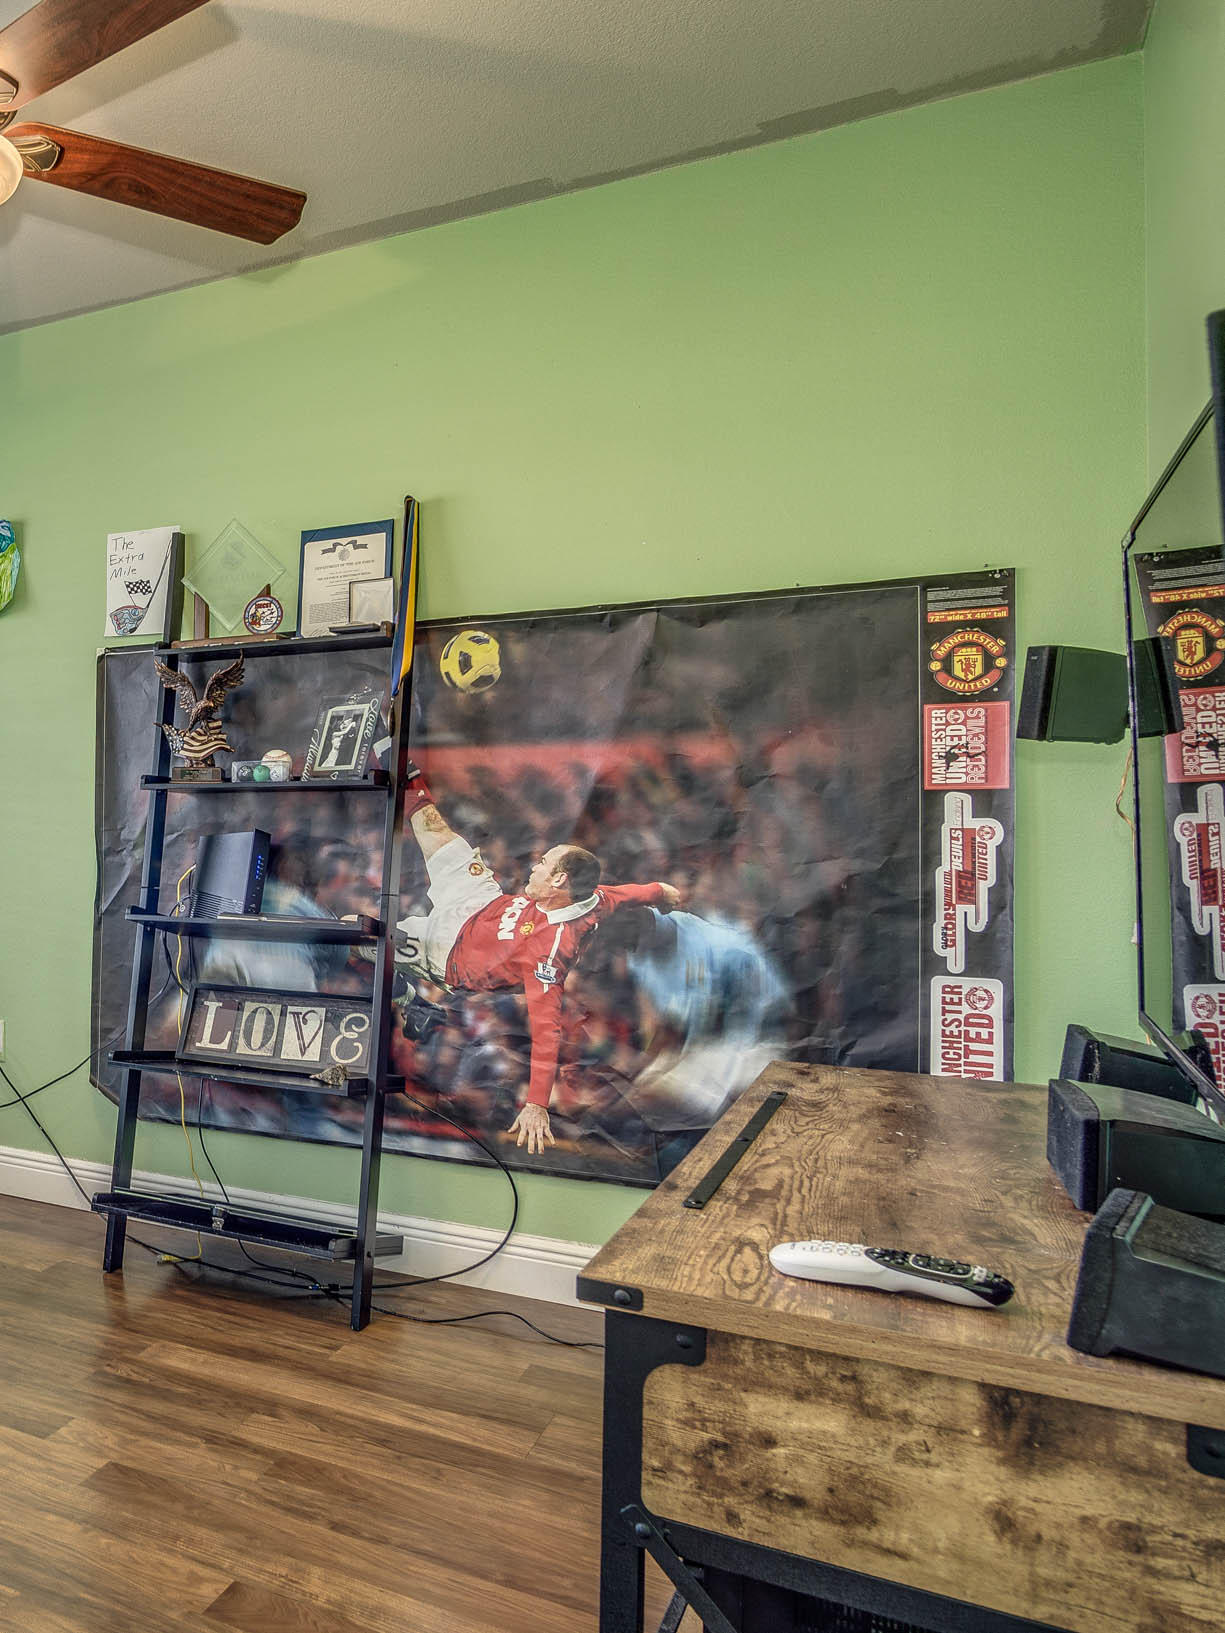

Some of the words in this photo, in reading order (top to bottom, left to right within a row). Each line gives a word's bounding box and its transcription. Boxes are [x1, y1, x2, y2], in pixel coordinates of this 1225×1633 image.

[109, 553, 144, 566] Extra
[111, 536, 135, 552] The
[110, 566, 137, 581] Mile
[936, 633, 1000, 656] MANCHESTER
[947, 678, 991, 690] UNITED
[931, 709, 946, 784] MANCHESTER
[946, 725, 967, 784] UNED
[951, 829, 963, 871] DEVILS
[977, 840, 988, 881] UNITED
[497, 896, 530, 940] AON
[944, 903, 956, 949] GLORY
[195, 1001, 370, 1064] LOVE
[941, 984, 963, 1077] NCHESTER
[963, 1012, 994, 1080] NITED
